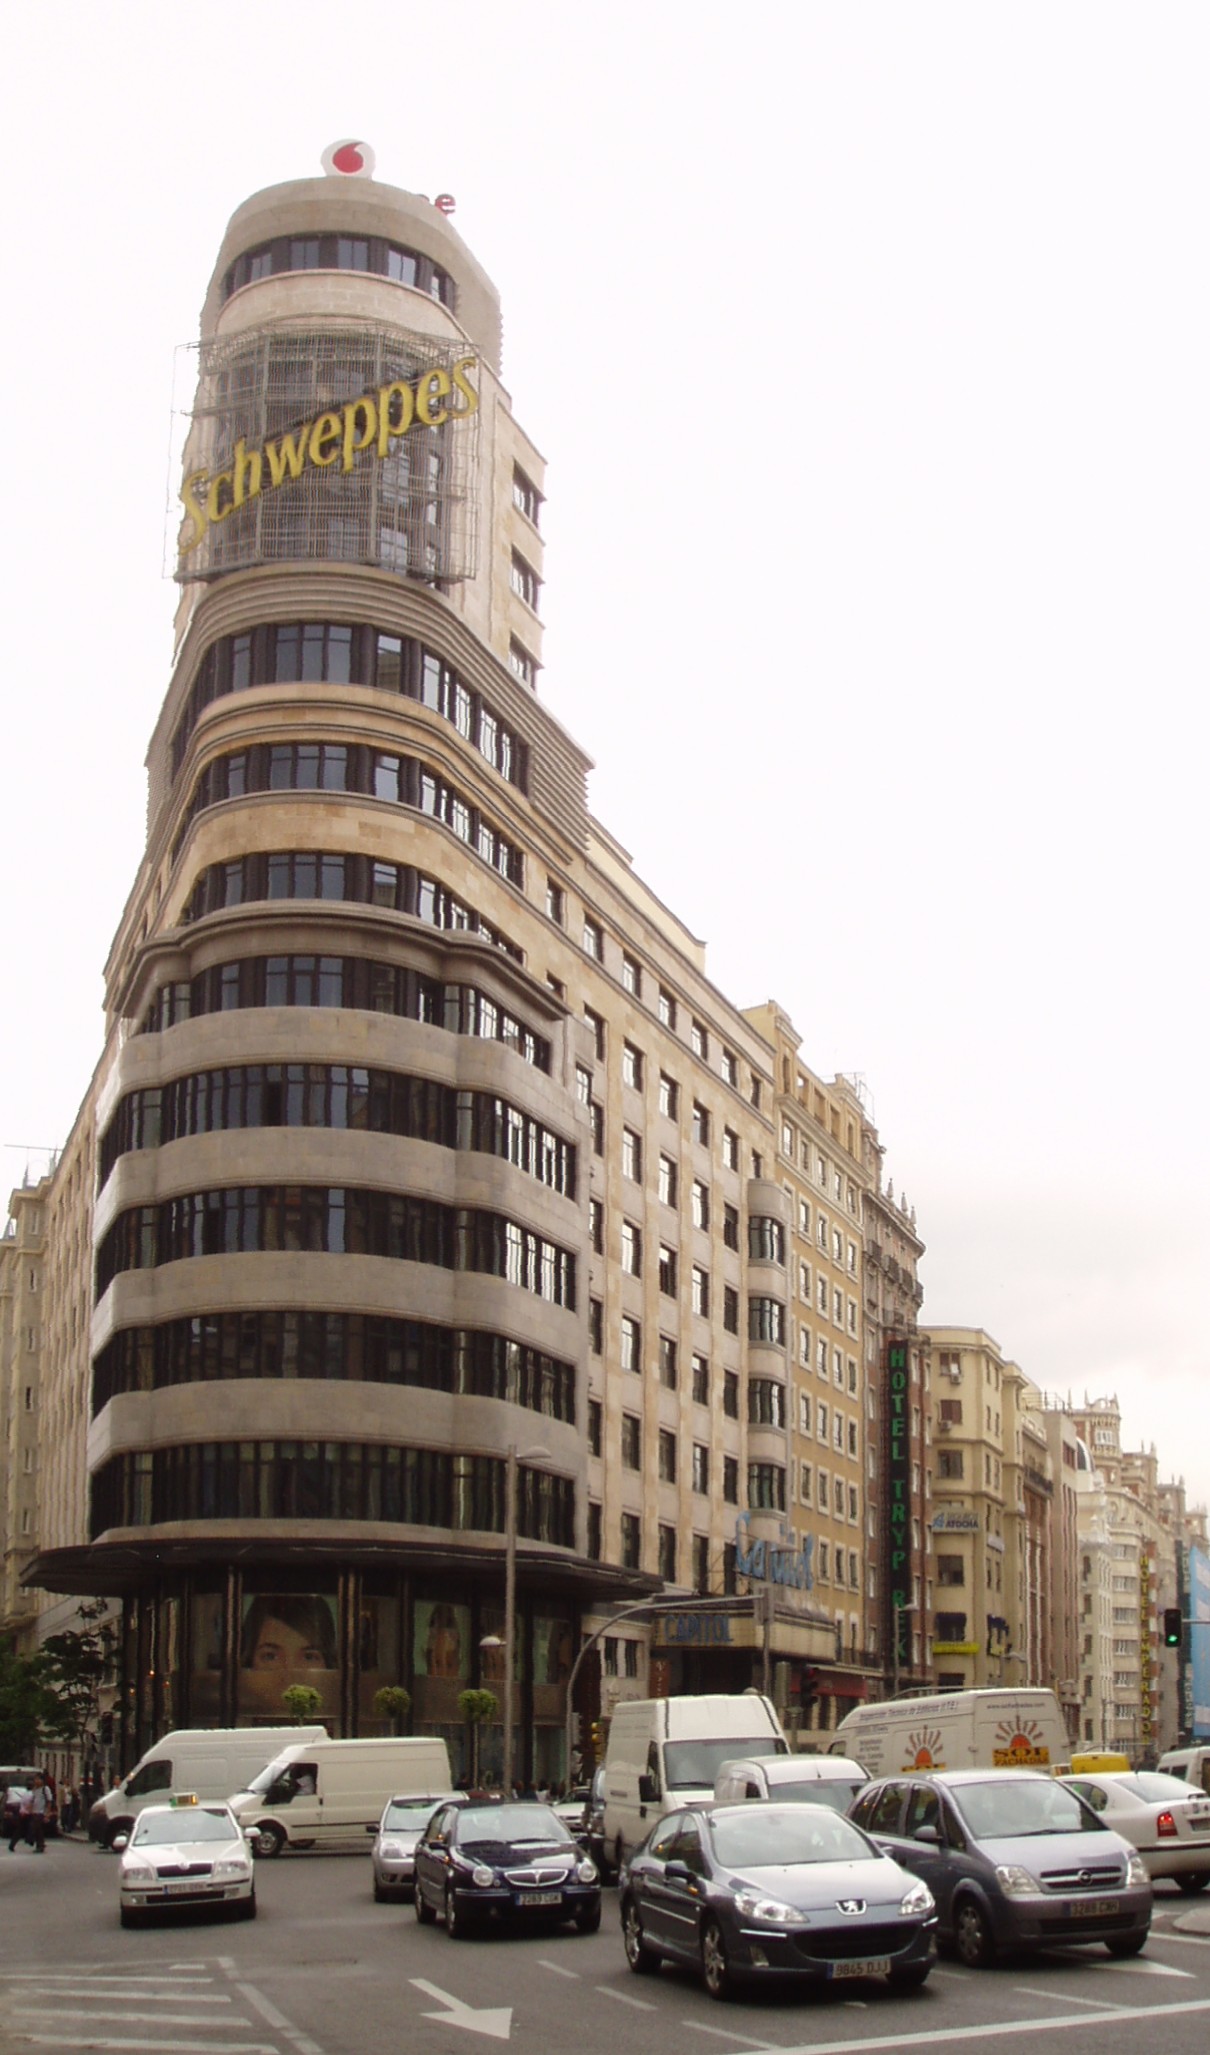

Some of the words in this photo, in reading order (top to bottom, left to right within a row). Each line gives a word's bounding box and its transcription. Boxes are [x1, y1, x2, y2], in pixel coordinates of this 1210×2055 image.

[179, 356, 478, 556] Schweppes
[890, 1348, 906, 1461] HOTEL
[891, 1479, 905, 1570] TRYP
[664, 1615, 734, 1643] CAPITOL
[836, 1962, 863, 1976] 9845
